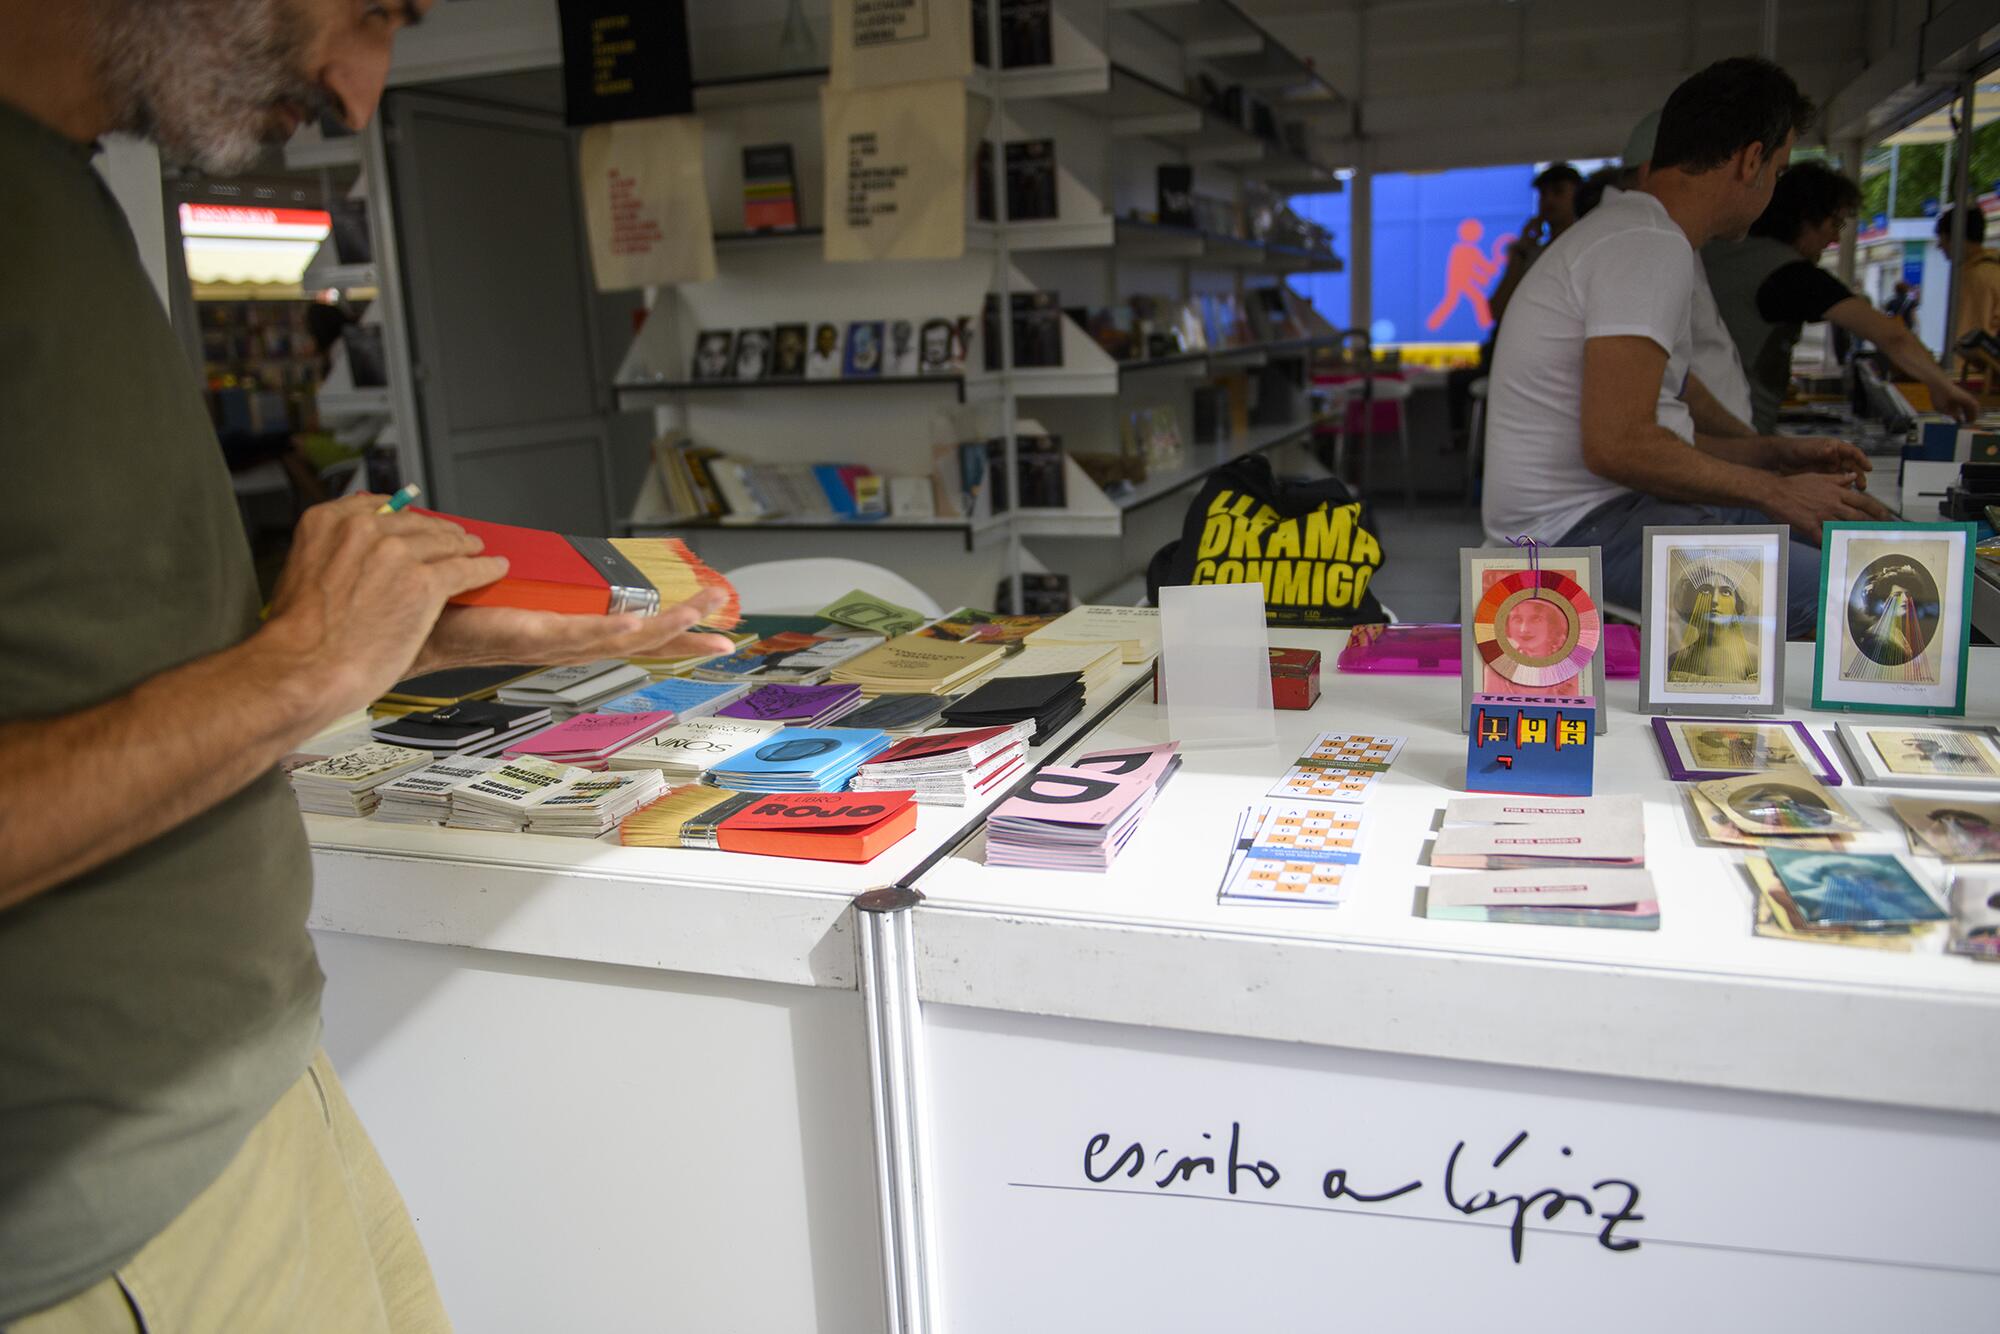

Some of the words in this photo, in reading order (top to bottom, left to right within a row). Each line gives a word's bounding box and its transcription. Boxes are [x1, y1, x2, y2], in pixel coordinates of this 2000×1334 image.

[1482, 695, 1586, 704] TICKETS
[481, 779, 531, 796] ERRORIST
[795, 795, 842, 804] LIBRO
[751, 803, 886, 818] ROJO
[1084, 1122, 1280, 1194] escrito
[1323, 1169, 1422, 1202] a
[1445, 1131, 1644, 1263] lápiz
